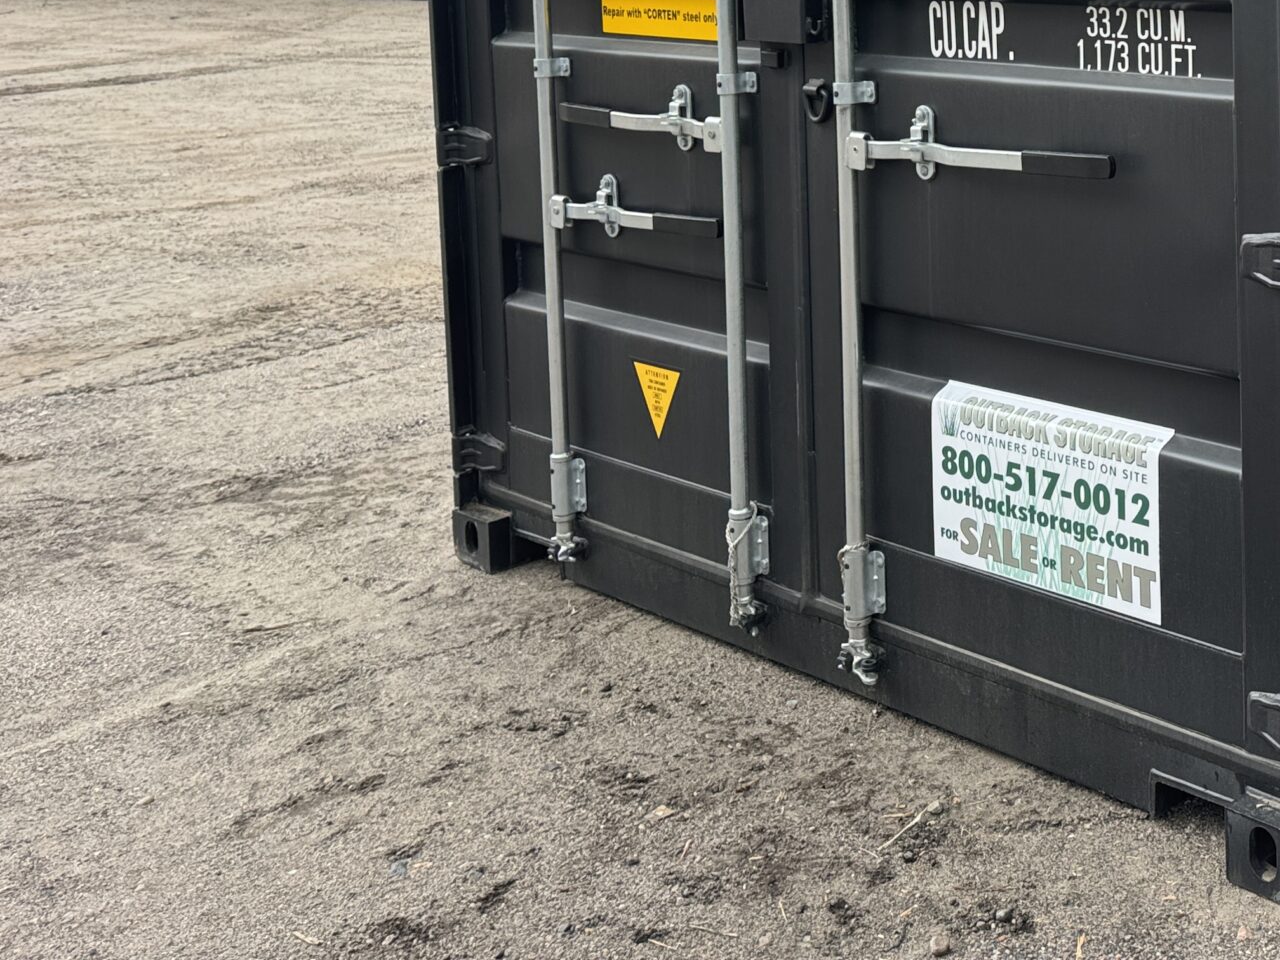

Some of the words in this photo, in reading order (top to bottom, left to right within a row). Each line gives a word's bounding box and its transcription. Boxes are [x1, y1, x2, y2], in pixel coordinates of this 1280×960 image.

[603, 5, 625, 19] Repair
[627, 7, 642, 19] with
[644, 8, 680, 21] "CORTEN"
[682, 12, 701, 23] steel
[1085, 6, 1129, 39] 33.2
[1136, 8, 1192, 44] CU.M.
[1076, 38, 1130, 74] 1,173
[1137, 42, 1202, 79] CU.FT.
[959, 395, 1059, 446] OUTBACK
[1053, 417, 1156, 469] STORAGE
[959, 429, 1027, 455] CONTAINERS
[1031, 447, 1095, 471] DELIVERED
[1100, 463, 1117, 477] ON
[1122, 469, 1149, 484] SITE
[941, 445, 1150, 527] 800-517-0012
[941, 485, 1149, 557] outbackstorage.com
[940, 526, 959, 542] FOR
[959, 517, 1039, 575] SALE
[1042, 556, 1057, 571] OR
[1060, 543, 1157, 610] RENT
